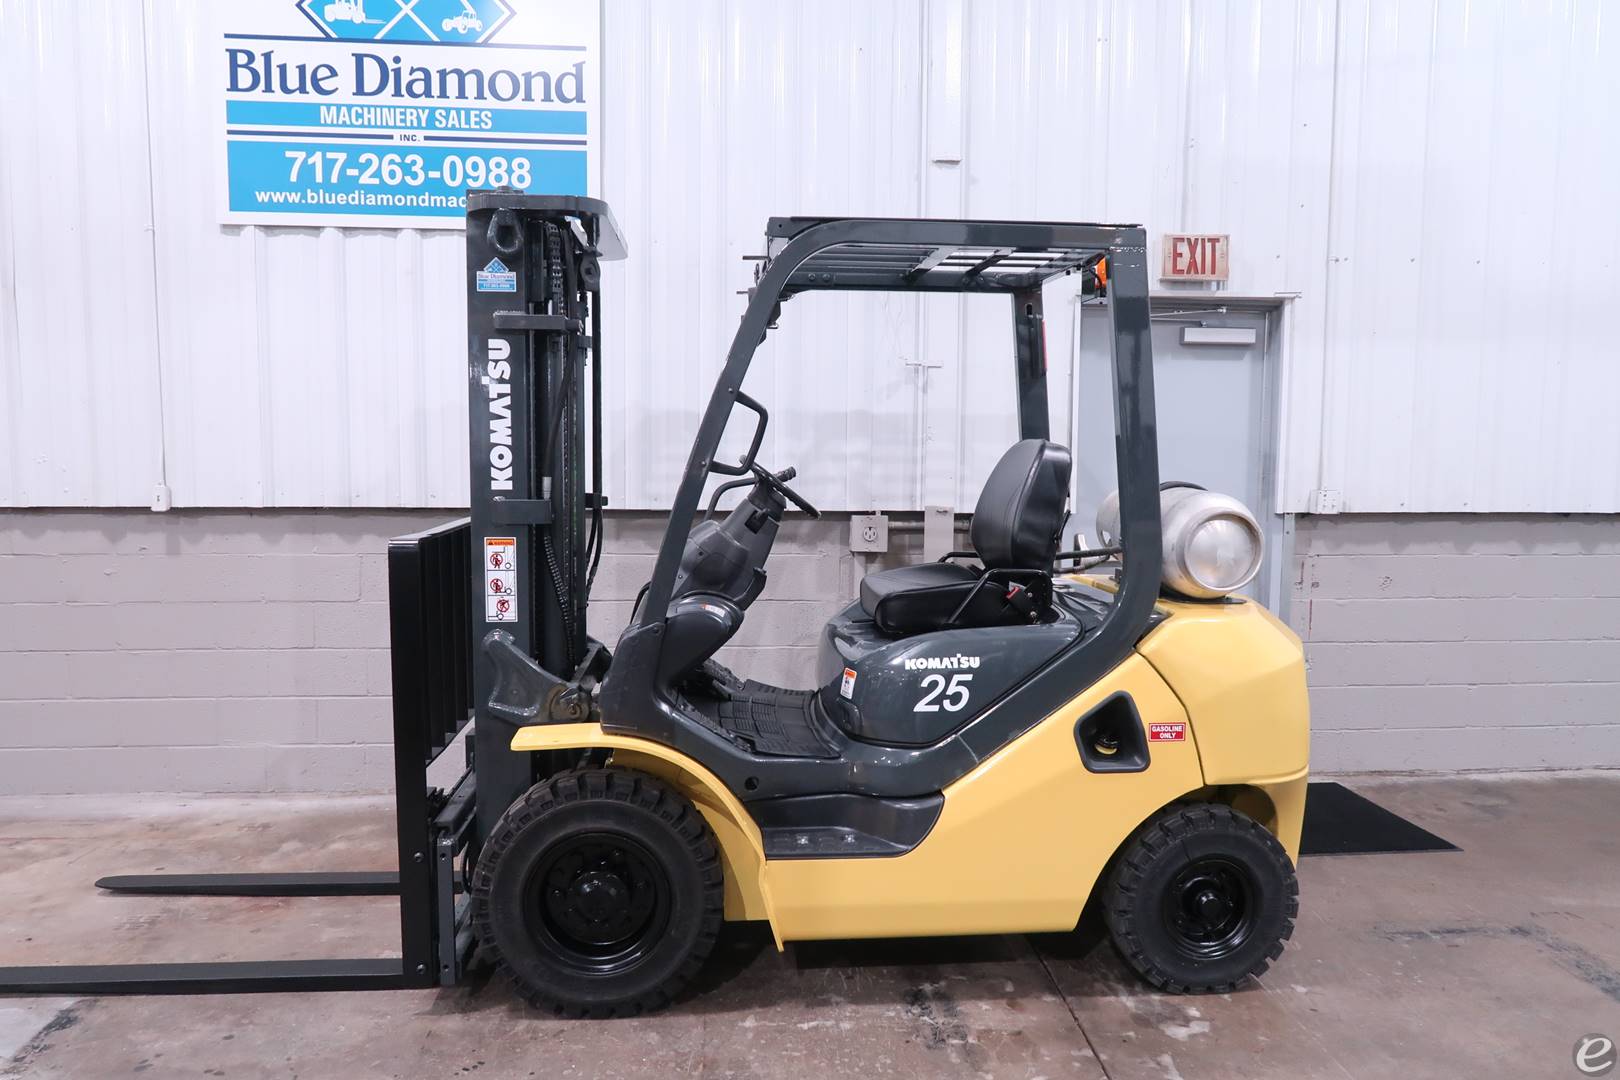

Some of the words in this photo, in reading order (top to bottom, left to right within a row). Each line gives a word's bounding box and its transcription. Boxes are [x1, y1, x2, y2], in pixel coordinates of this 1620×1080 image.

[225, 48, 339, 96] Blue
[351, 52, 586, 104] Diamond
[320, 105, 429, 128] MACHINERY
[434, 109, 492, 129] SALES
[399, 133, 421, 142] INC.
[284, 150, 532, 189] 717-263-0988
[1172, 237, 1220, 275] EXIT
[481, 338, 513, 490] KOMATSU
[904, 653, 980, 670] KOMATSU
[913, 673, 973, 712] 25
